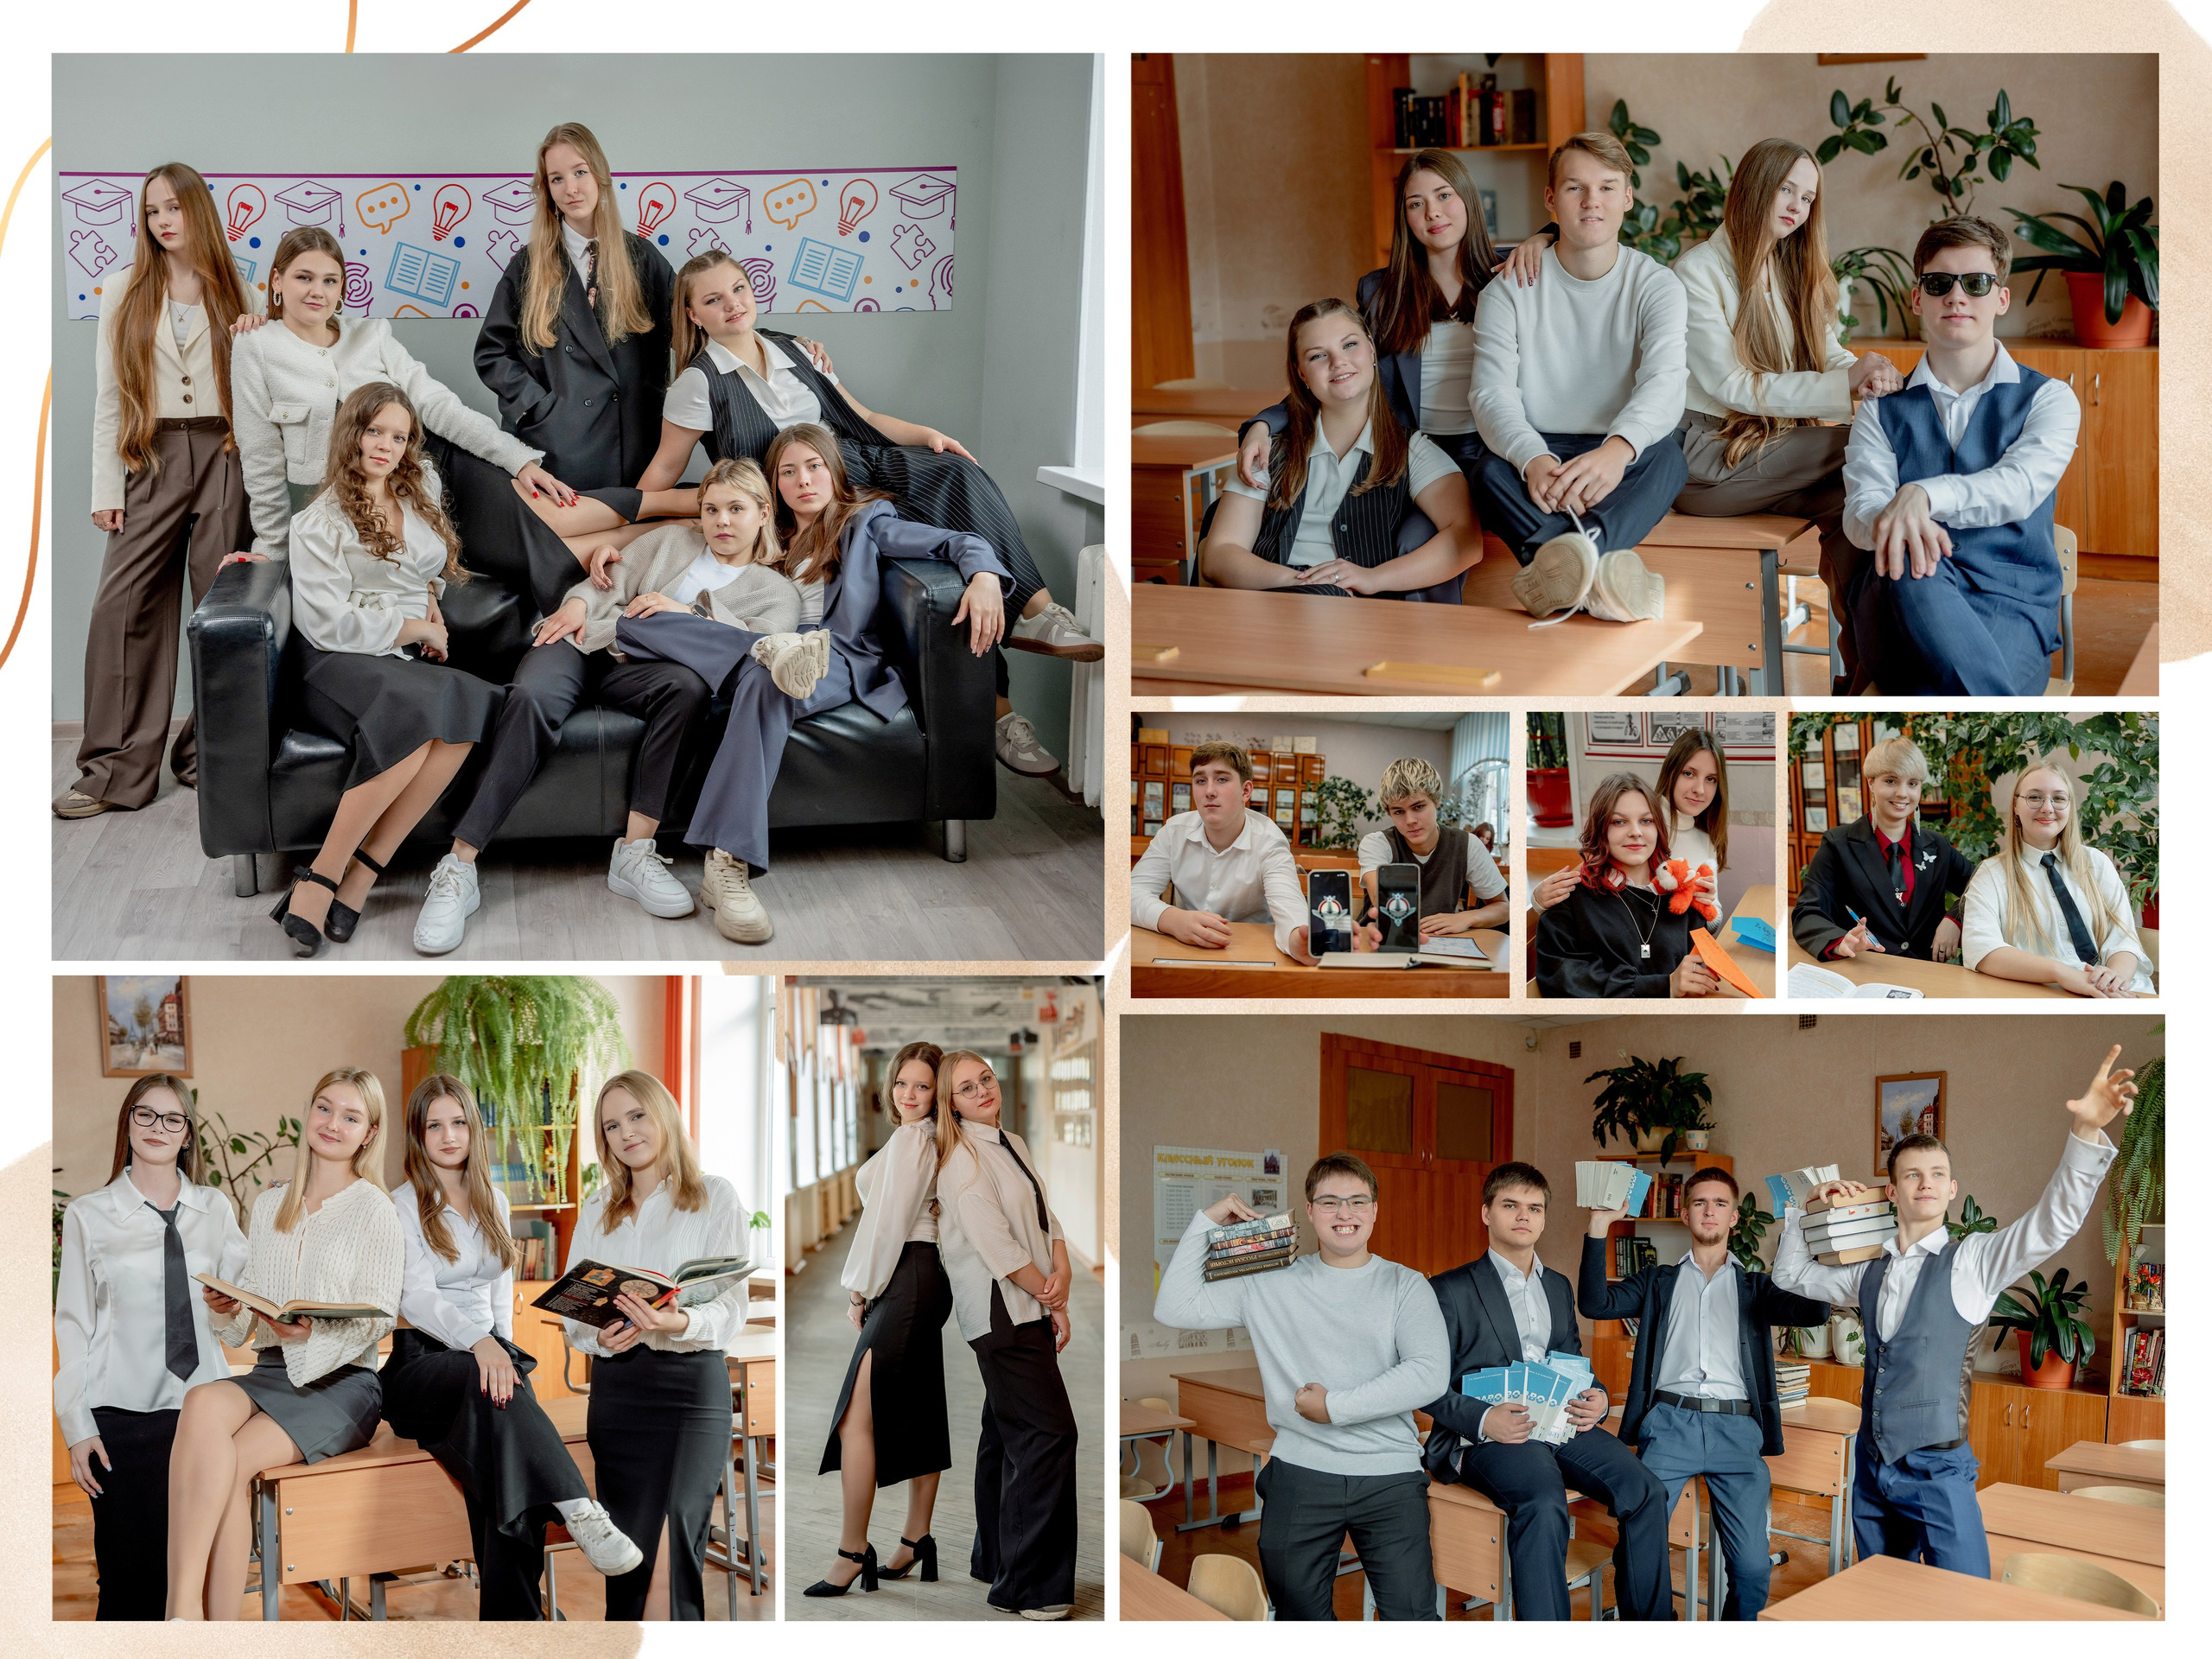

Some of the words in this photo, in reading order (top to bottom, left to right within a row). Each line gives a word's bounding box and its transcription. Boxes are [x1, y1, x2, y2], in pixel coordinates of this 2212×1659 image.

[1157, 1153, 1214, 1166] КЛАССНЫЙ
[1217, 1157, 1255, 1168] УГОЛОК
[1235, 1255, 1257, 1263] РУССКАЯ
